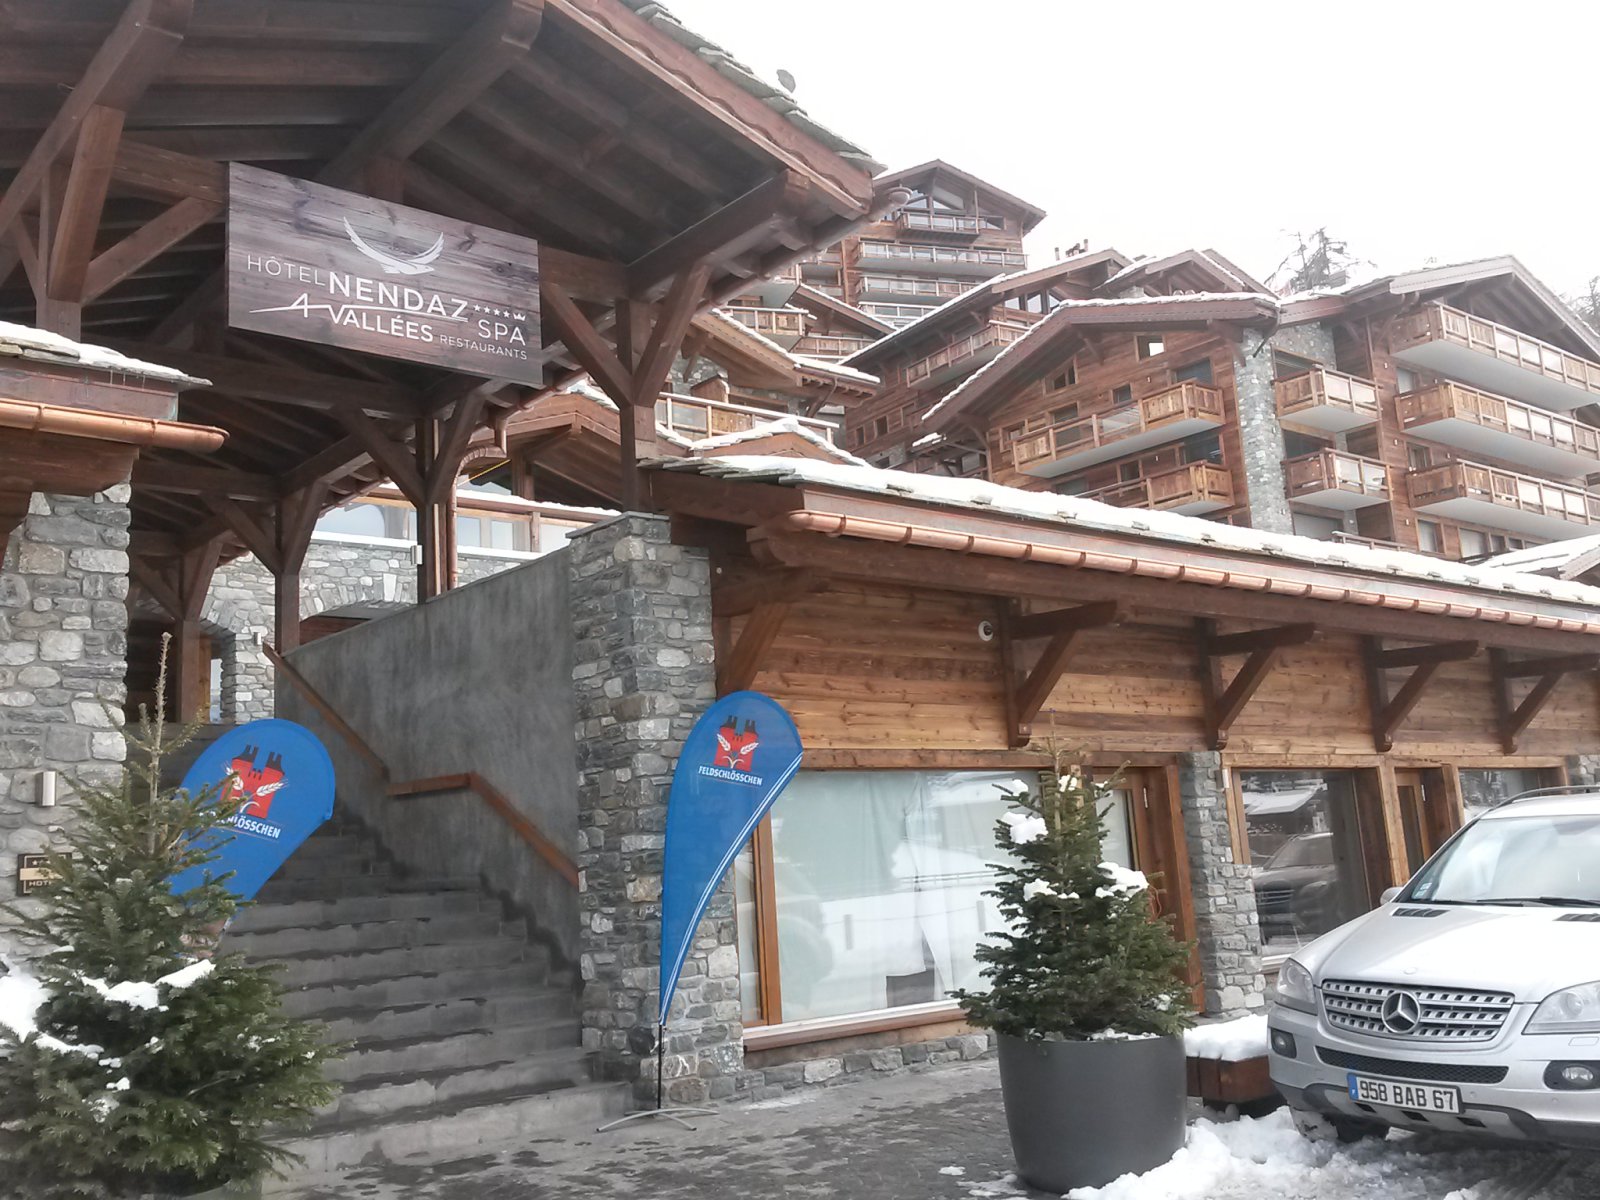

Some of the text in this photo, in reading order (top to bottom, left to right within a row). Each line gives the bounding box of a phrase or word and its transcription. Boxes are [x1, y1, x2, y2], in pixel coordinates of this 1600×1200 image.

[247, 254, 468, 322] HÔTEL NENDAZ
[328, 304, 433, 342] VALLÉES
[478, 319, 526, 346] SPA
[440, 334, 527, 360] RESTAURANTS
[698, 765, 763, 785] FELDSCHLÖSSCHEN
[1360, 1080, 1388, 1101] 958
[1393, 1085, 1427, 1107] BAB
[1432, 1090, 1454, 1110] 67
